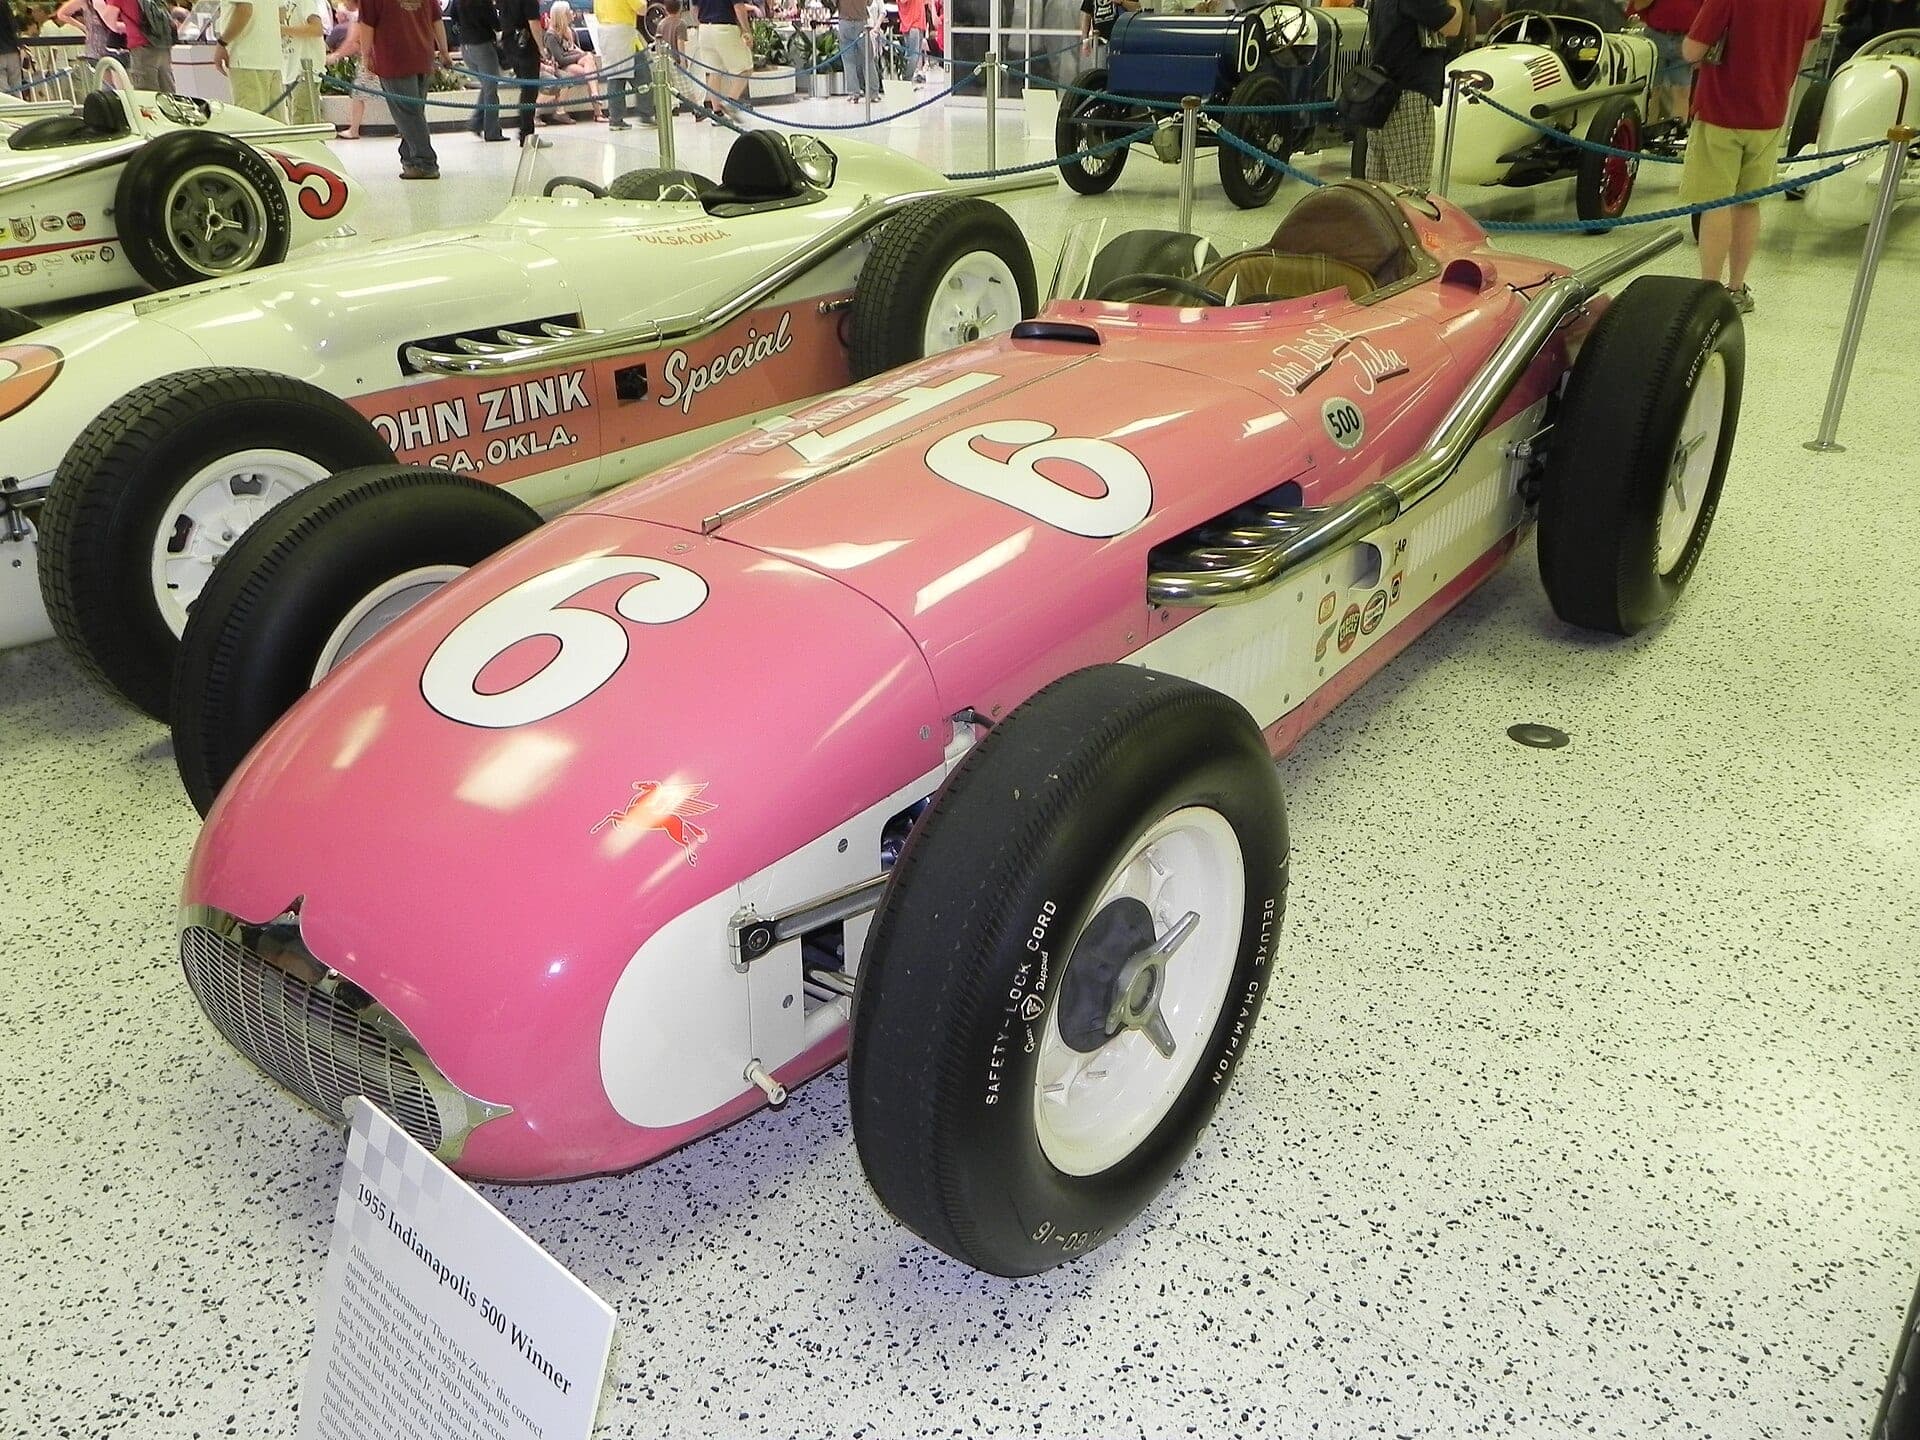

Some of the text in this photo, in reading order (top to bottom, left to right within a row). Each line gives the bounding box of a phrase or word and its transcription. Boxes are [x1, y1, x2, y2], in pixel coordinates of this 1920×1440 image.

[1236, 22, 1270, 74] 16
[370, 310, 793, 451] OHN ZINK Special
[1257, 361, 1311, 397] John
[1272, 337, 1334, 372] Zink
[1338, 340, 1409, 395] Tulsa
[1327, 405, 1360, 438] 500
[923, 418, 1154, 539] 6
[418, 554, 711, 730] 6
[1026, 900, 1057, 952] CORD
[1211, 898, 1275, 1086] DELUXE CHAMPION
[357, 1183, 572, 1395] 1955 Indianapolis 500 Winner
[331, 1340, 340, 1357] in
[380, 1391, 398, 1418] This
[334, 1322, 347, 1346] lap
[347, 1336, 357, 1354] 58
[356, 1350, 372, 1370] and
[371, 1362, 385, 1384] led
[384, 1379, 390, 1391] a
[390, 1384, 410, 1410] total
[409, 1404, 420, 1420] of
[418, 1412, 430, 1431] 86
[337, 1307, 355, 1333] back
[355, 1325, 364, 1343] in
[382, 1354, 399, 1378] Bob
[398, 1371, 433, 1415] Sweikert
[340, 1294, 353, 1311] car
[352, 1307, 377, 1335] owner
[375, 1328, 395, 1356] John
[403, 1355, 423, 1384] Zink
[346, 1261, 509, 1428] name for the color of the 1955 Indianapolis
[350, 1244, 385, 1285] Although
[385, 1279, 428, 1326] nicknamed
[448, 1338, 468, 1366] Pink
[496, 1385, 511, 1408] the
[511, 1404, 543, 1439] correct
[390, 1322, 439, 1379] Kurtis-Kraft
[438, 1371, 462, 1400] 500D
[461, 1396, 482, 1424] was,
[325, 1372, 355, 1411] banquet
[353, 1407, 373, 1435] gave
[328, 1359, 347, 1382] chief
[346, 1378, 382, 1420] mechanic
[381, 1413, 394, 1433] for
